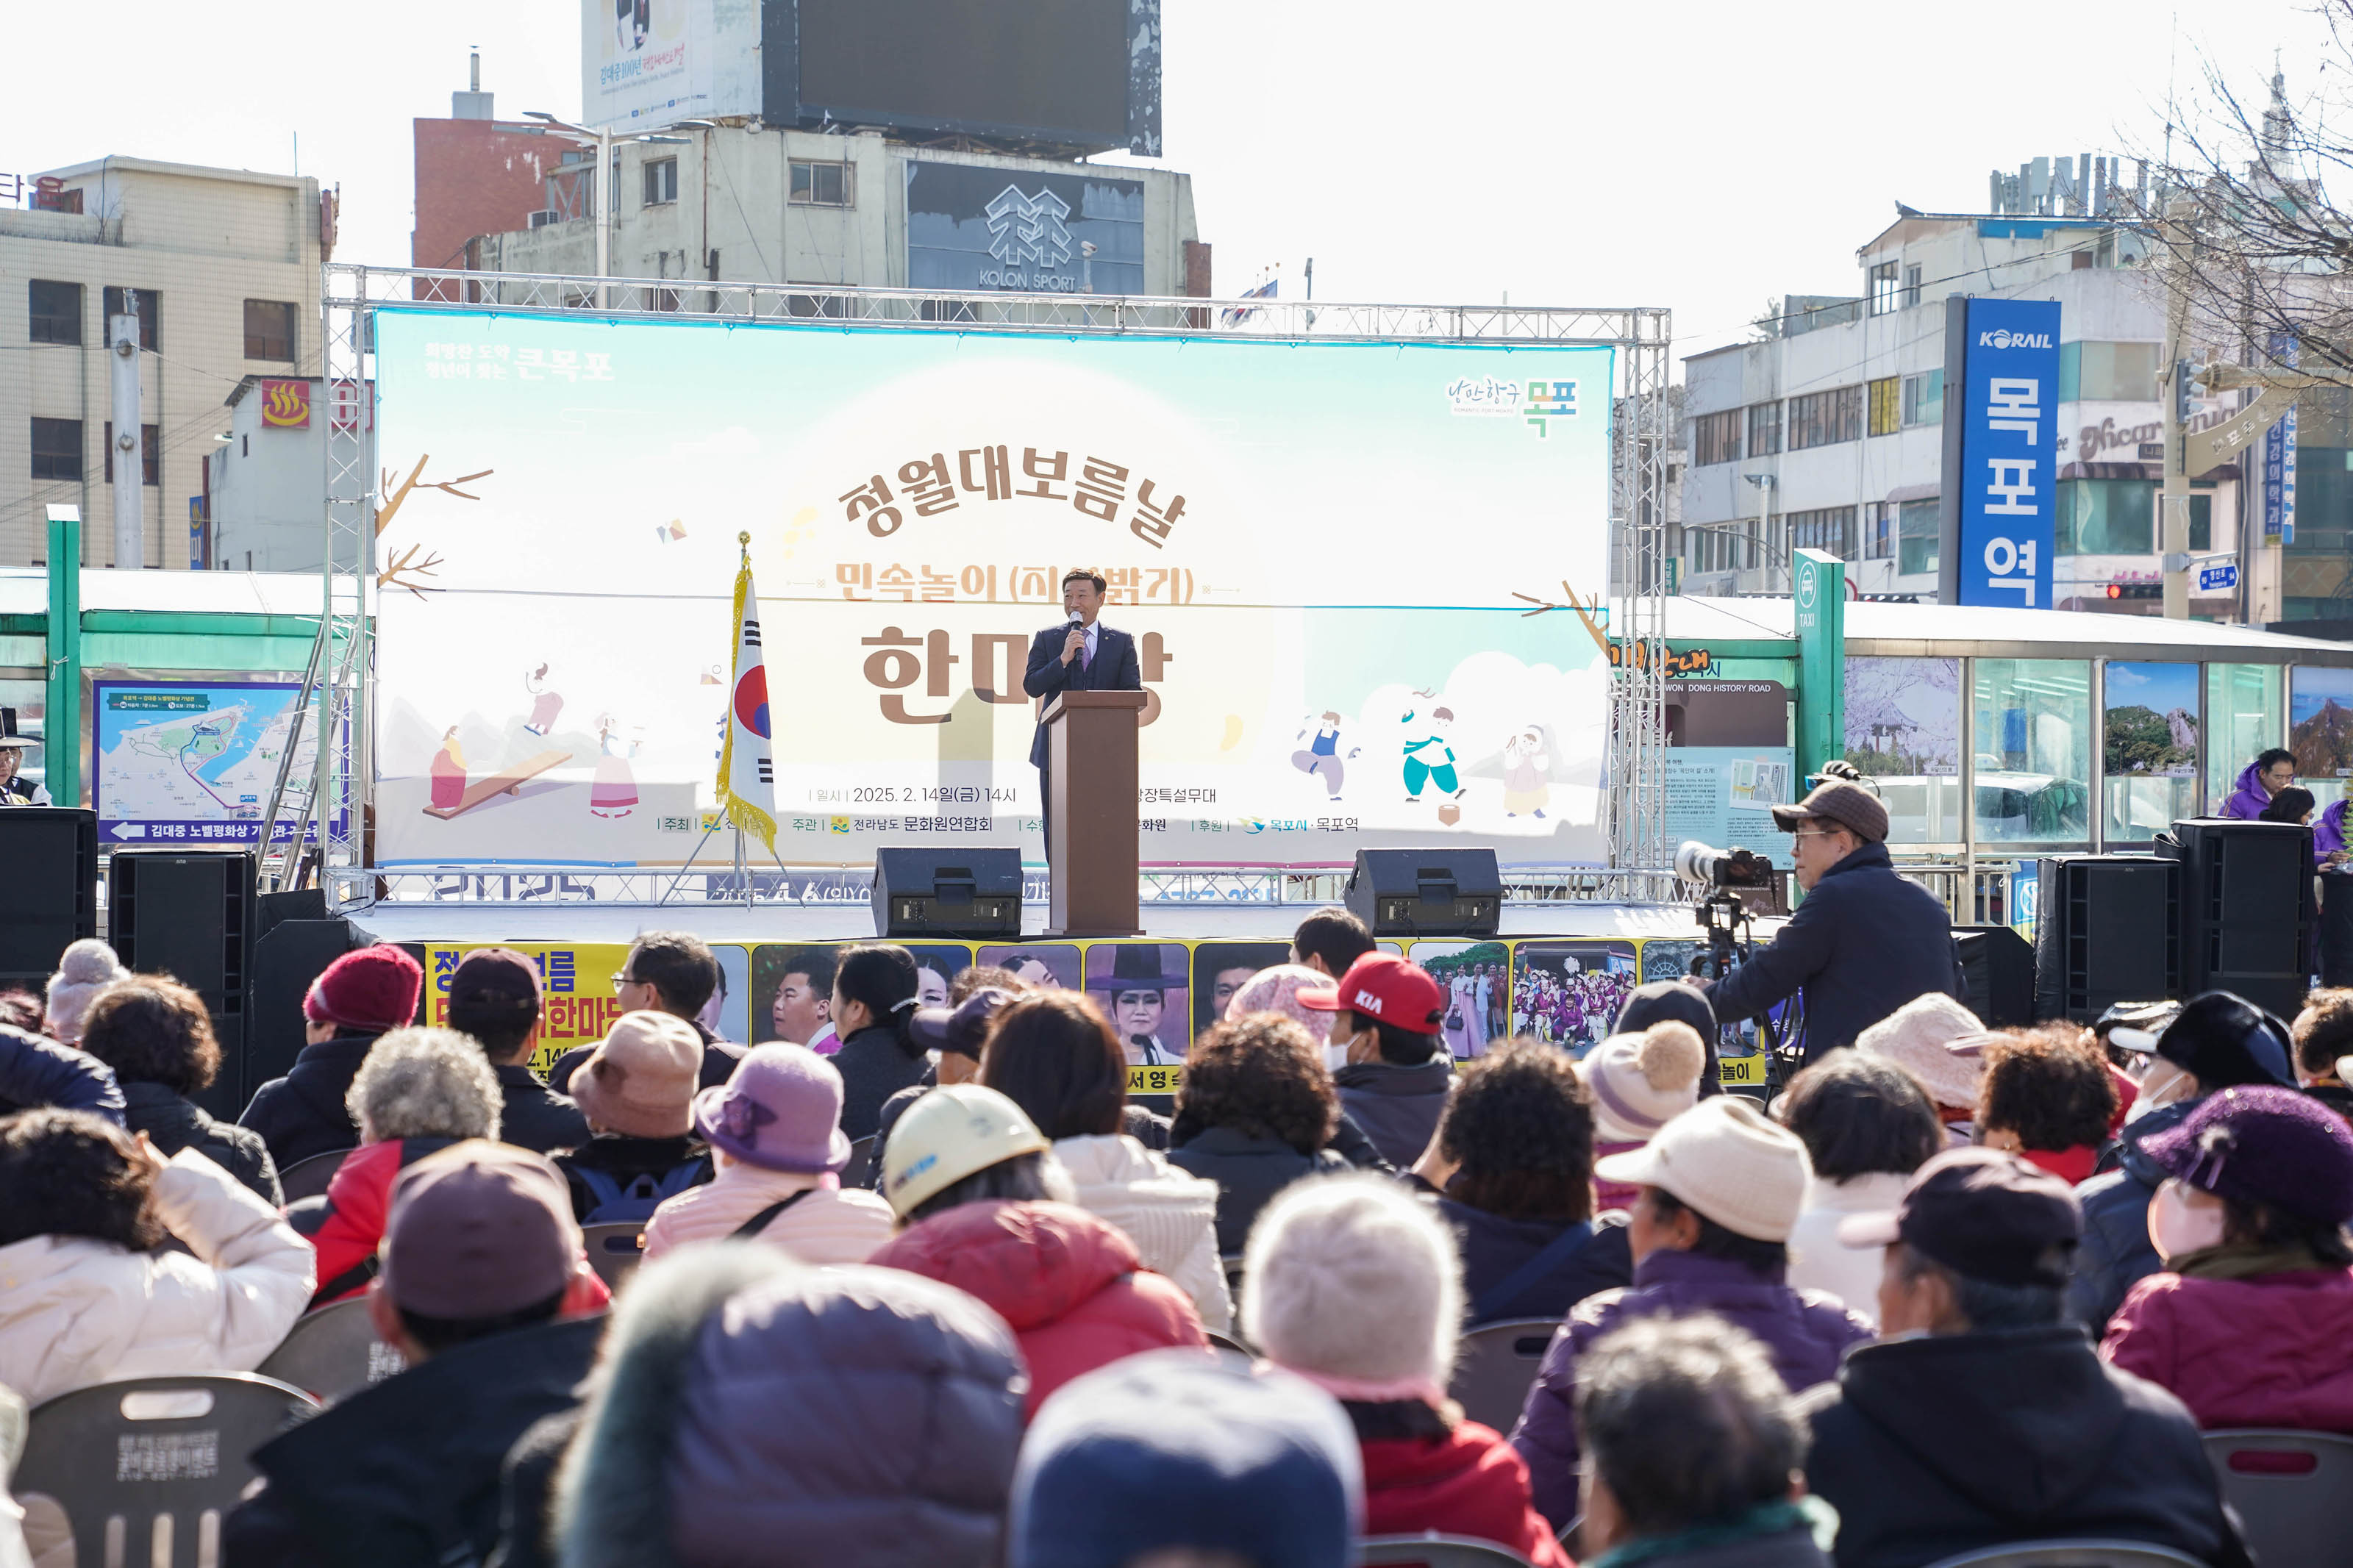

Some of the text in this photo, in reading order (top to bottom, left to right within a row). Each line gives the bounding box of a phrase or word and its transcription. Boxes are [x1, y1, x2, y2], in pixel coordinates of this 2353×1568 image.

[979, 270, 1076, 292] KOLON SPORT
[1979, 329, 2052, 349] KORAIL
[838, 445, 1186, 549] 정월대보름날
[1985, 377, 2040, 607] 목포역
[1009, 565, 1194, 606] (지밝기)
[1799, 613, 1815, 627] TAXI
[1688, 684, 1712, 692] DONG
[1713, 684, 1747, 692] HISTORY
[1749, 684, 1771, 692] ROAD
[817, 787, 1016, 803] 일시 2025. 2. 14일(금) 14시
[151, 825, 186, 837] 김대중
[190, 824, 248, 837] 노벨평화상
[251, 825, 285, 837] 기관
[665, 817, 689, 831] 주최
[793, 817, 993, 832] 주관 전라남도 문화원연합회
[1199, 817, 1359, 832] 후원 목포시 목포역
[1354, 988, 1383, 1014] KIA
